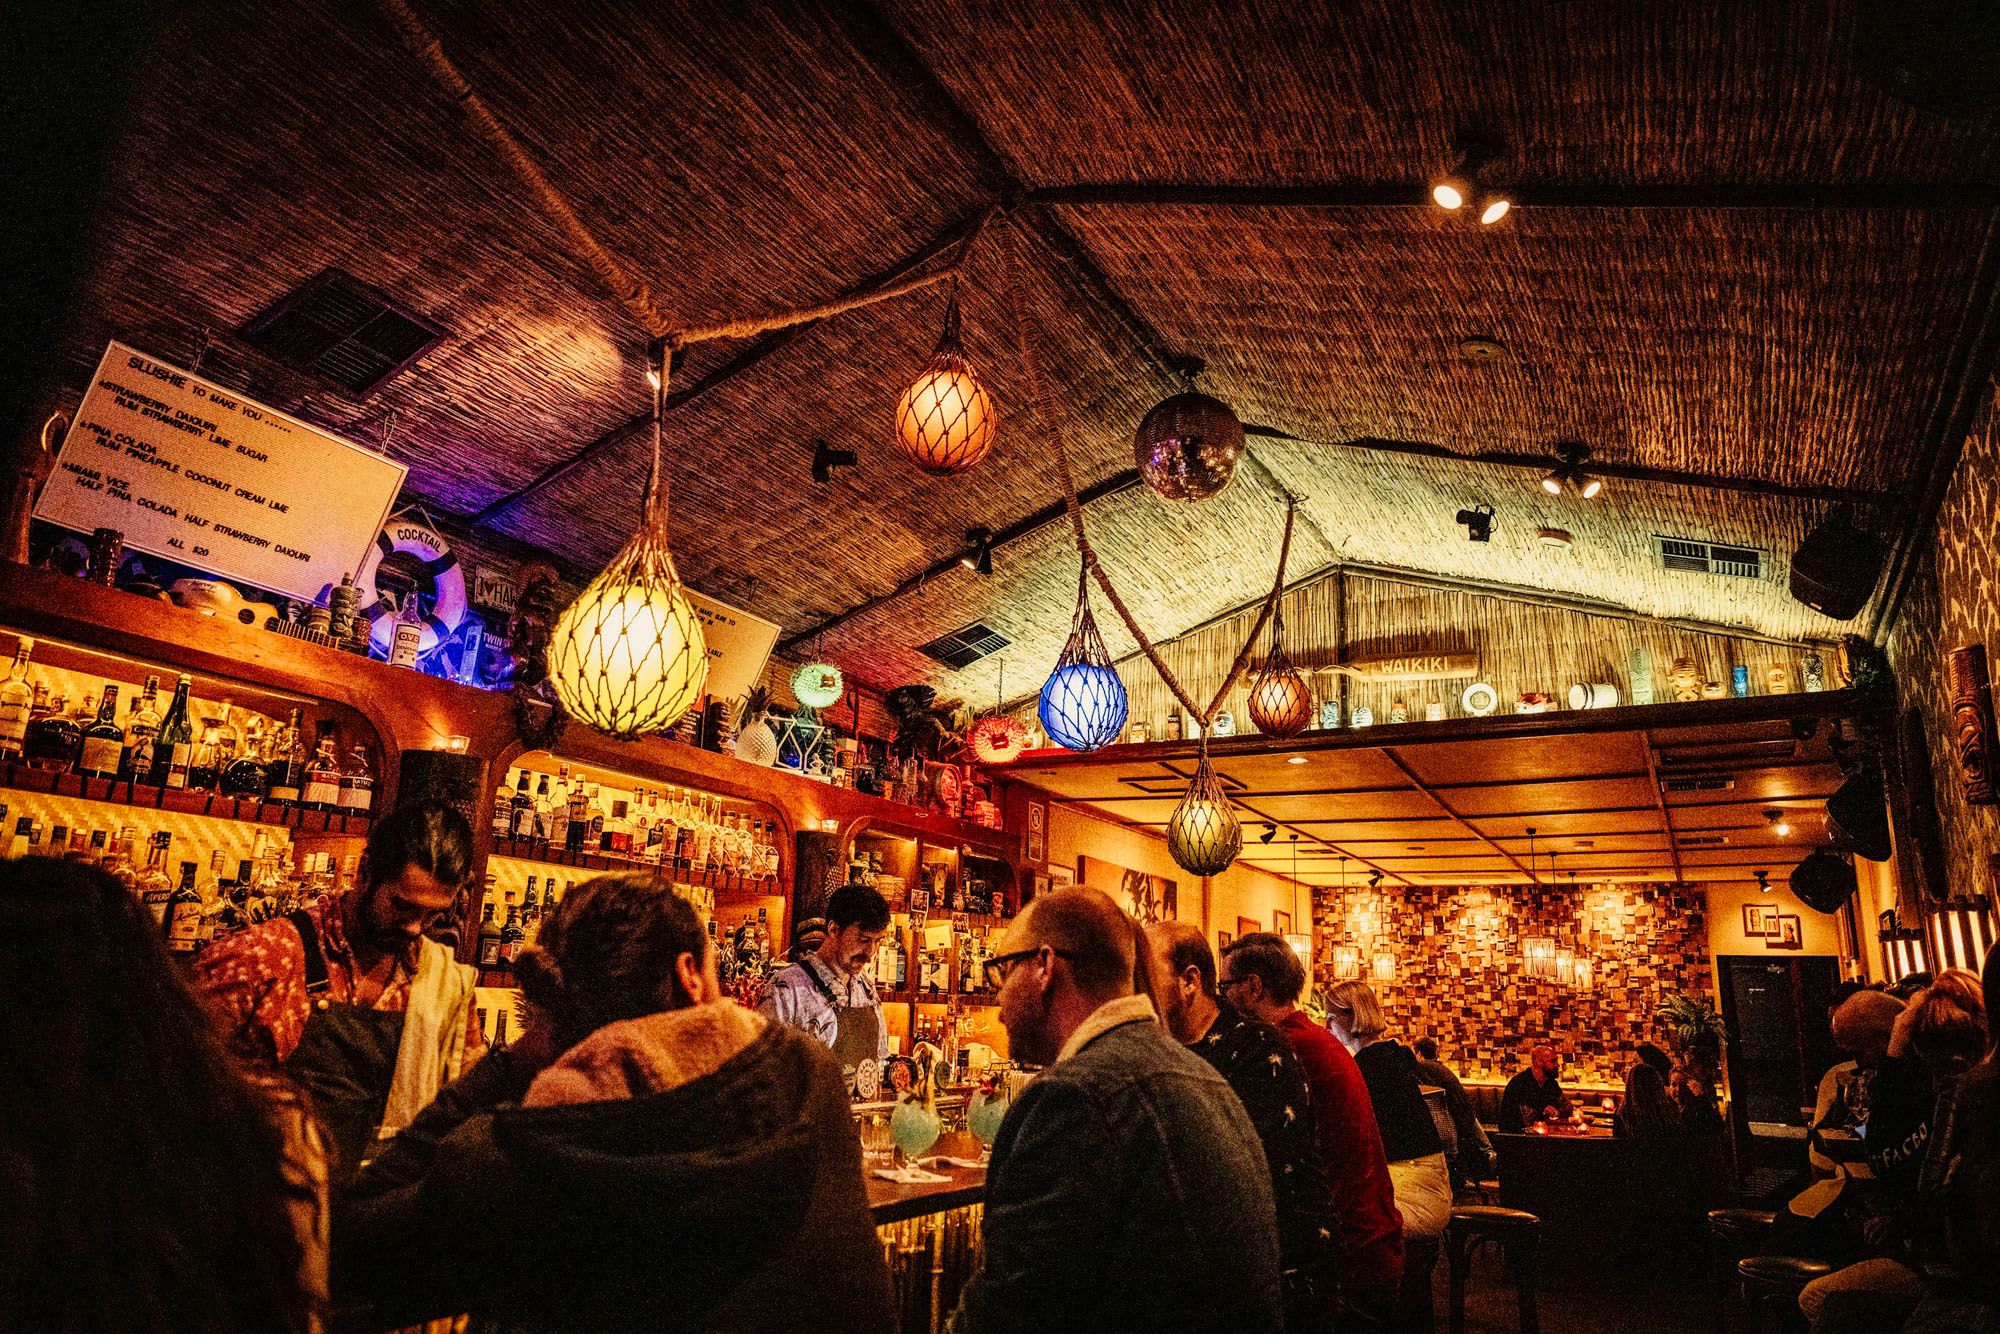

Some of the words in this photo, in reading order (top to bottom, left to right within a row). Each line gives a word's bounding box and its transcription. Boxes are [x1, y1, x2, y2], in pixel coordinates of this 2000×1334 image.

[128, 357, 187, 389] SLUSHIE
[193, 386, 206, 397] TO
[209, 394, 238, 411] MAKE
[242, 406, 263, 421] YOU
[114, 396, 139, 411] RUM
[141, 407, 205, 437] STRAWBERRY
[208, 433, 232, 449] LIME
[236, 444, 268, 463] SUGAR
[175, 410, 218, 433] DAIQUIRI
[114, 433, 157, 455] COLADA
[95, 436, 121, 451] RUM
[125, 447, 180, 474] PINEAPPLE
[184, 469, 232, 492] COCONUT
[234, 488, 266, 505] CREAM
[268, 500, 289, 513] LIME
[106, 475, 130, 491] VICE
[76, 476, 104, 491] HALF
[107, 487, 131, 502] PINA
[137, 497, 177, 518] COLADA
[184, 513, 210, 527] HALF
[213, 524, 271, 548] STRAWBERRY
[274, 544, 311, 562] DAIQUIRI
[167, 537, 184, 549] ALL
[192, 546, 209, 557] $20
[397, 528, 441, 553] COCKTAIL
[399, 632, 419, 643] OVD
[483, 631, 502, 647] TWIN
[1381, 656, 1448, 673] WAIKIKI
